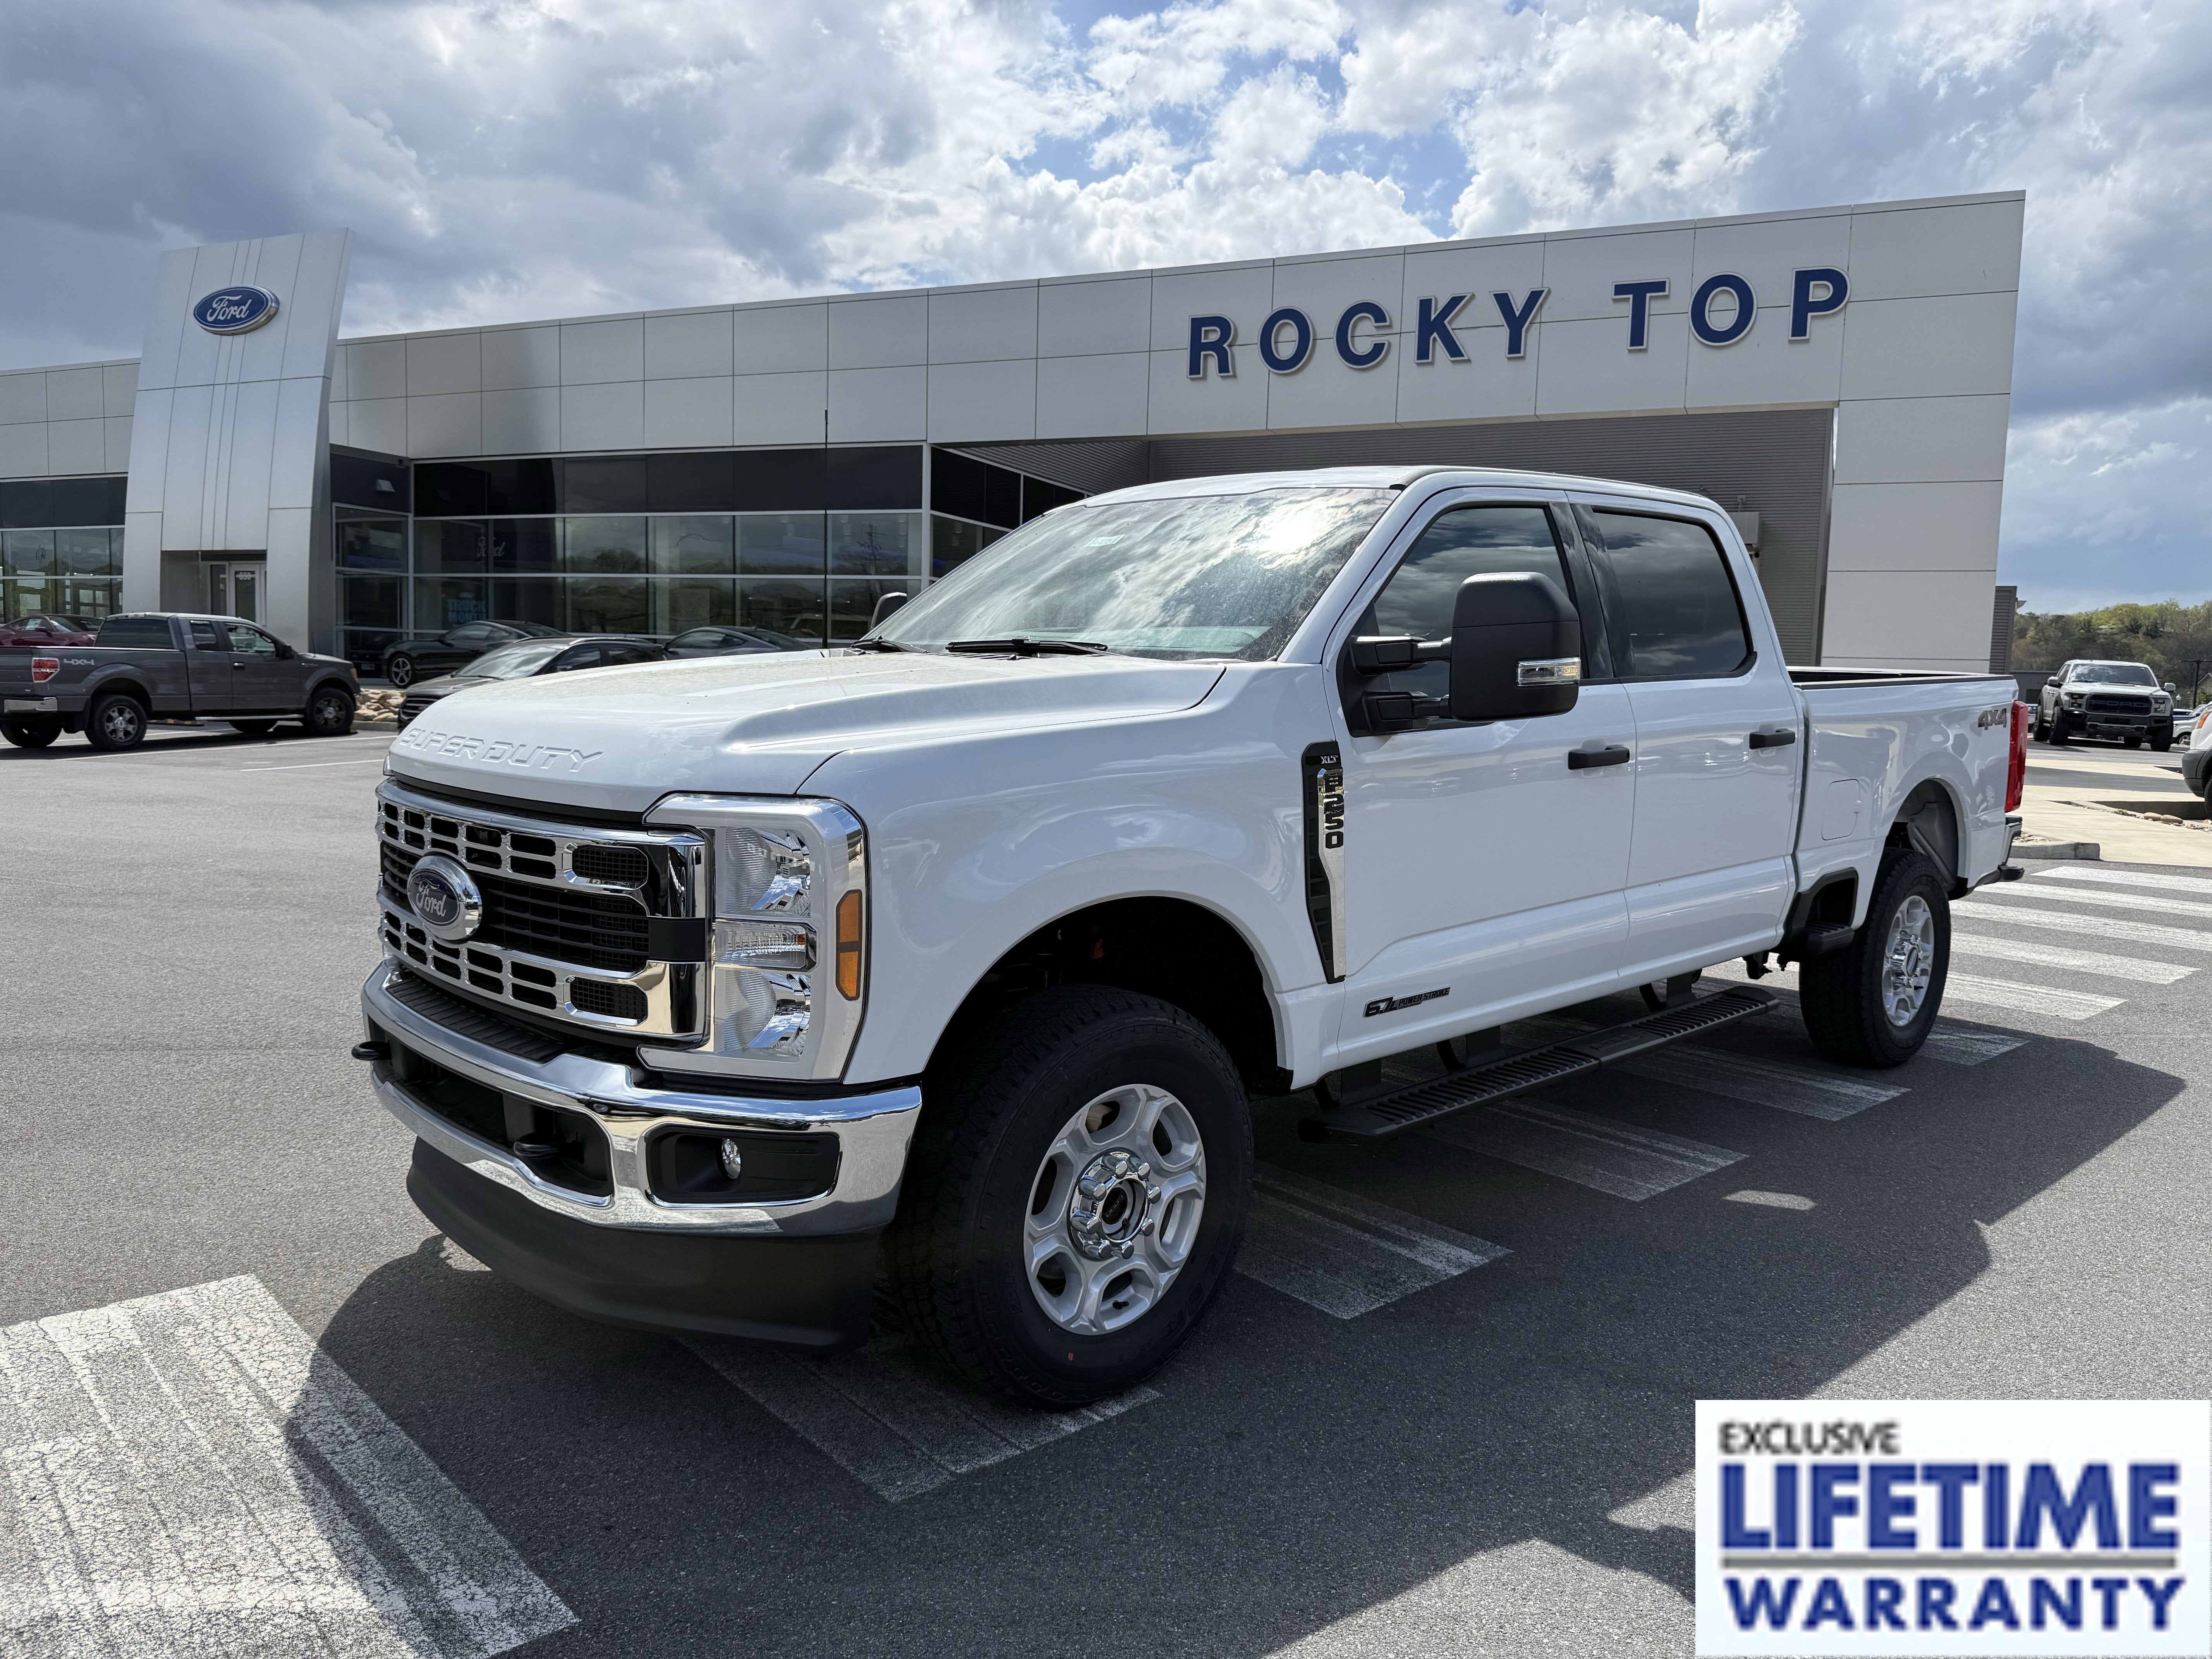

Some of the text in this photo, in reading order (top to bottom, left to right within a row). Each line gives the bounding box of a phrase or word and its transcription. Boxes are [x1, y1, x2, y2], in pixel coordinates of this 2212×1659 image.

[207, 295, 252, 321] Ford
[1187, 265, 1851, 380] ROCKY TOP
[399, 728, 603, 772] SUPER DUTY
[1321, 755, 1338, 764] XLT
[414, 878, 447, 917] Ford
[1398, 994, 1422, 1006] POWER
[1423, 988, 1450, 1000] STROKE
